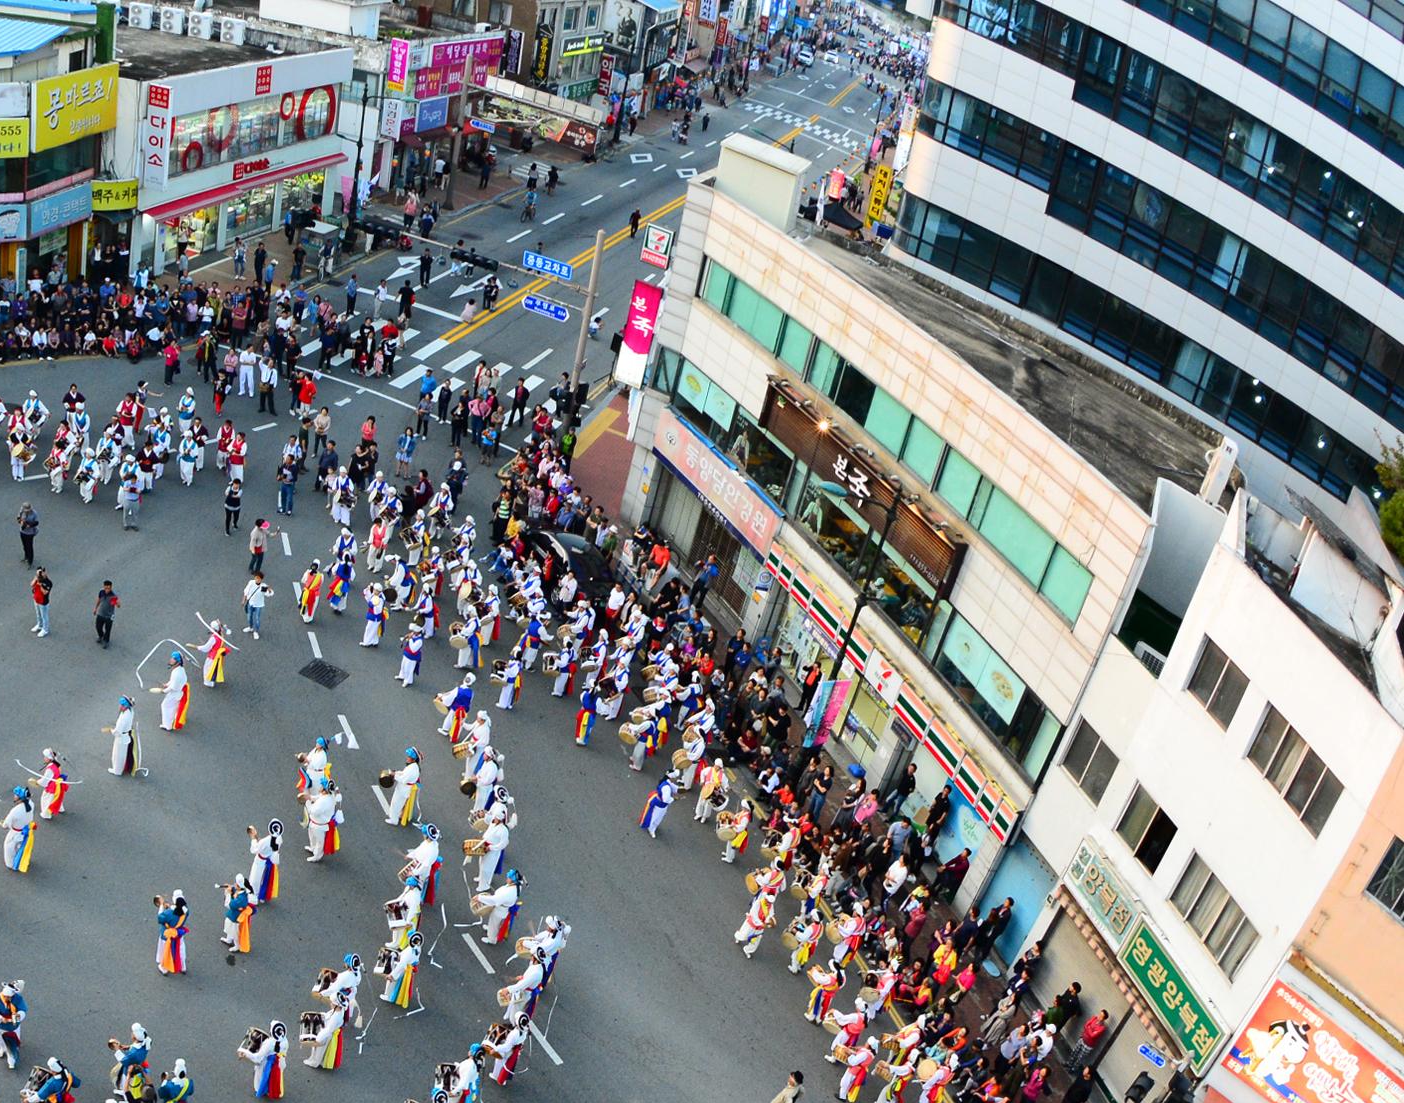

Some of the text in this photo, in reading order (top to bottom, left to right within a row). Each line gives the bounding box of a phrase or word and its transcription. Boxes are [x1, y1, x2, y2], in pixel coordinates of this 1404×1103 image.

[148, 115, 167, 167] 다이소
[526, 254, 570, 277] 중동교차로
[1132, 935, 1216, 1058] 영광양복점
